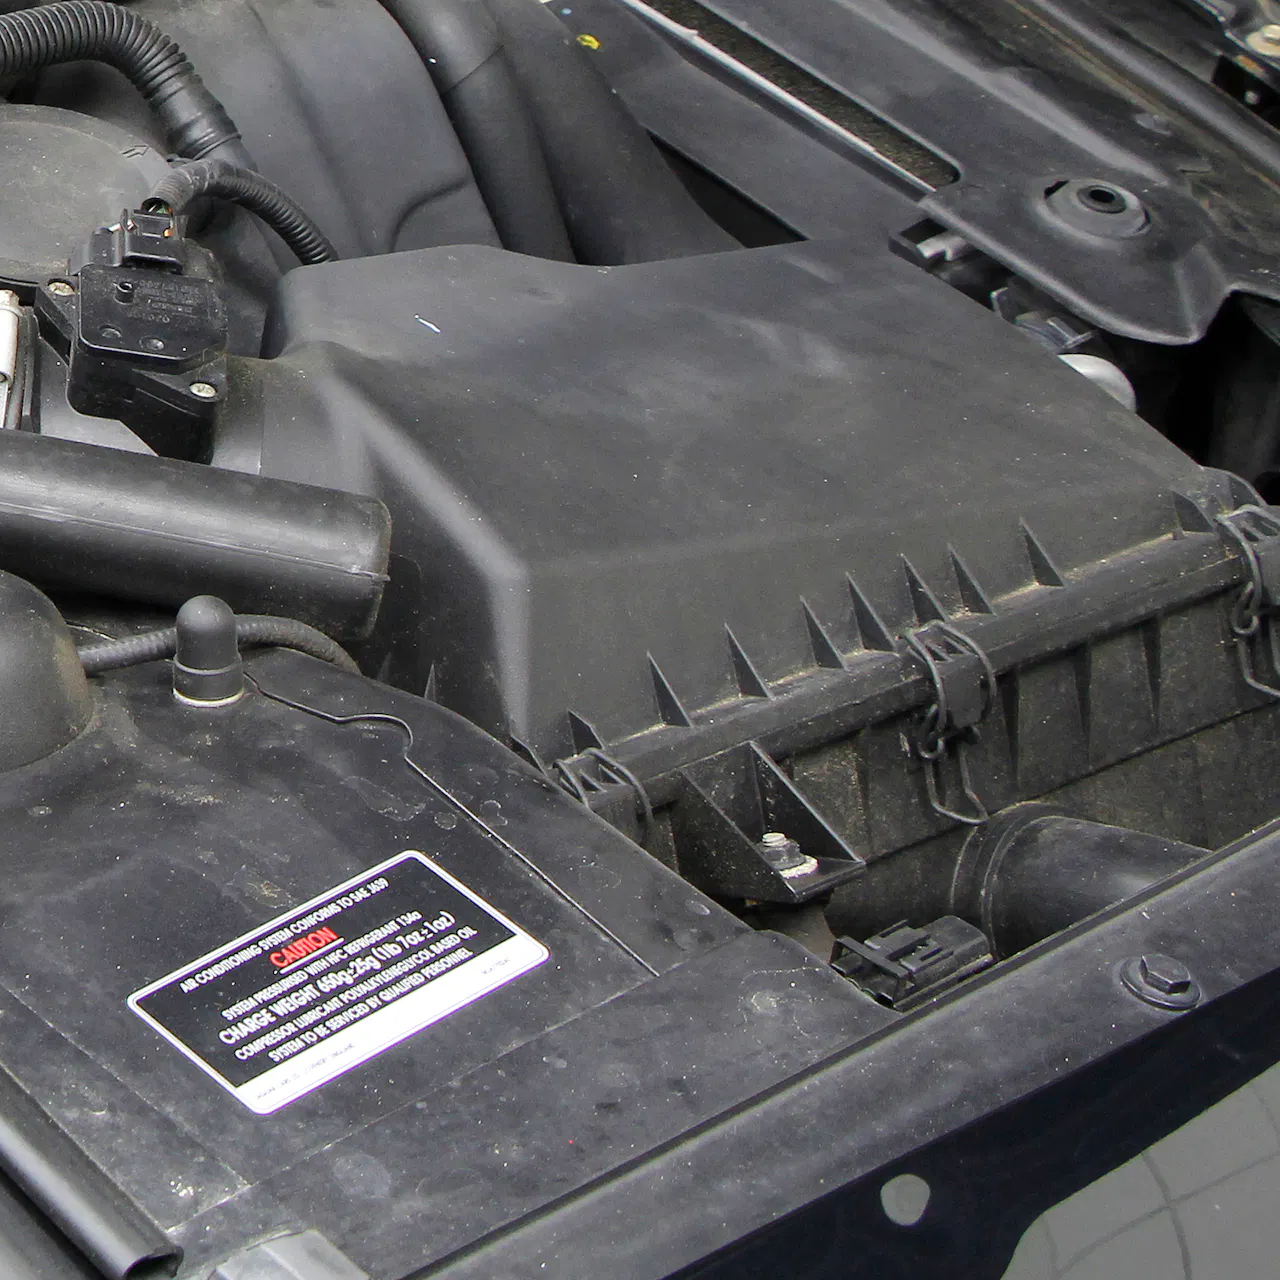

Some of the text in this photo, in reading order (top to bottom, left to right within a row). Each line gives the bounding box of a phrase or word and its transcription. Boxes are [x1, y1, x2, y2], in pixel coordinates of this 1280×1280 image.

[180, 978, 199, 993] AIR
[195, 945, 262, 984] CONDITIONING
[258, 928, 294, 950] SYSTEM
[290, 903, 341, 933] CONFORMS
[336, 897, 353, 908] TO
[349, 888, 371, 902] SAE
[222, 911, 421, 1022] SYSTEM PRESSURISED WITH HFC REFRIGERANT 134a
[235, 926, 477, 1060] COMPRESSOR LUBRICANT POLYALKYLENEGLYCOL BASED OIL
[269, 926, 339, 968] CAUTION
[219, 1009, 276, 1046] CHARGE
[269, 984, 320, 1017] WEIGHT
[268, 1038, 305, 1062] SYSTEM
[300, 1031, 317, 1044] TO
[313, 1024, 330, 1038] BE
[325, 1003, 370, 1032] SERVICED
[365, 995, 382, 1010] BY
[379, 973, 426, 1002] QUALIFIED
[421, 948, 473, 979] PERSONNEL
